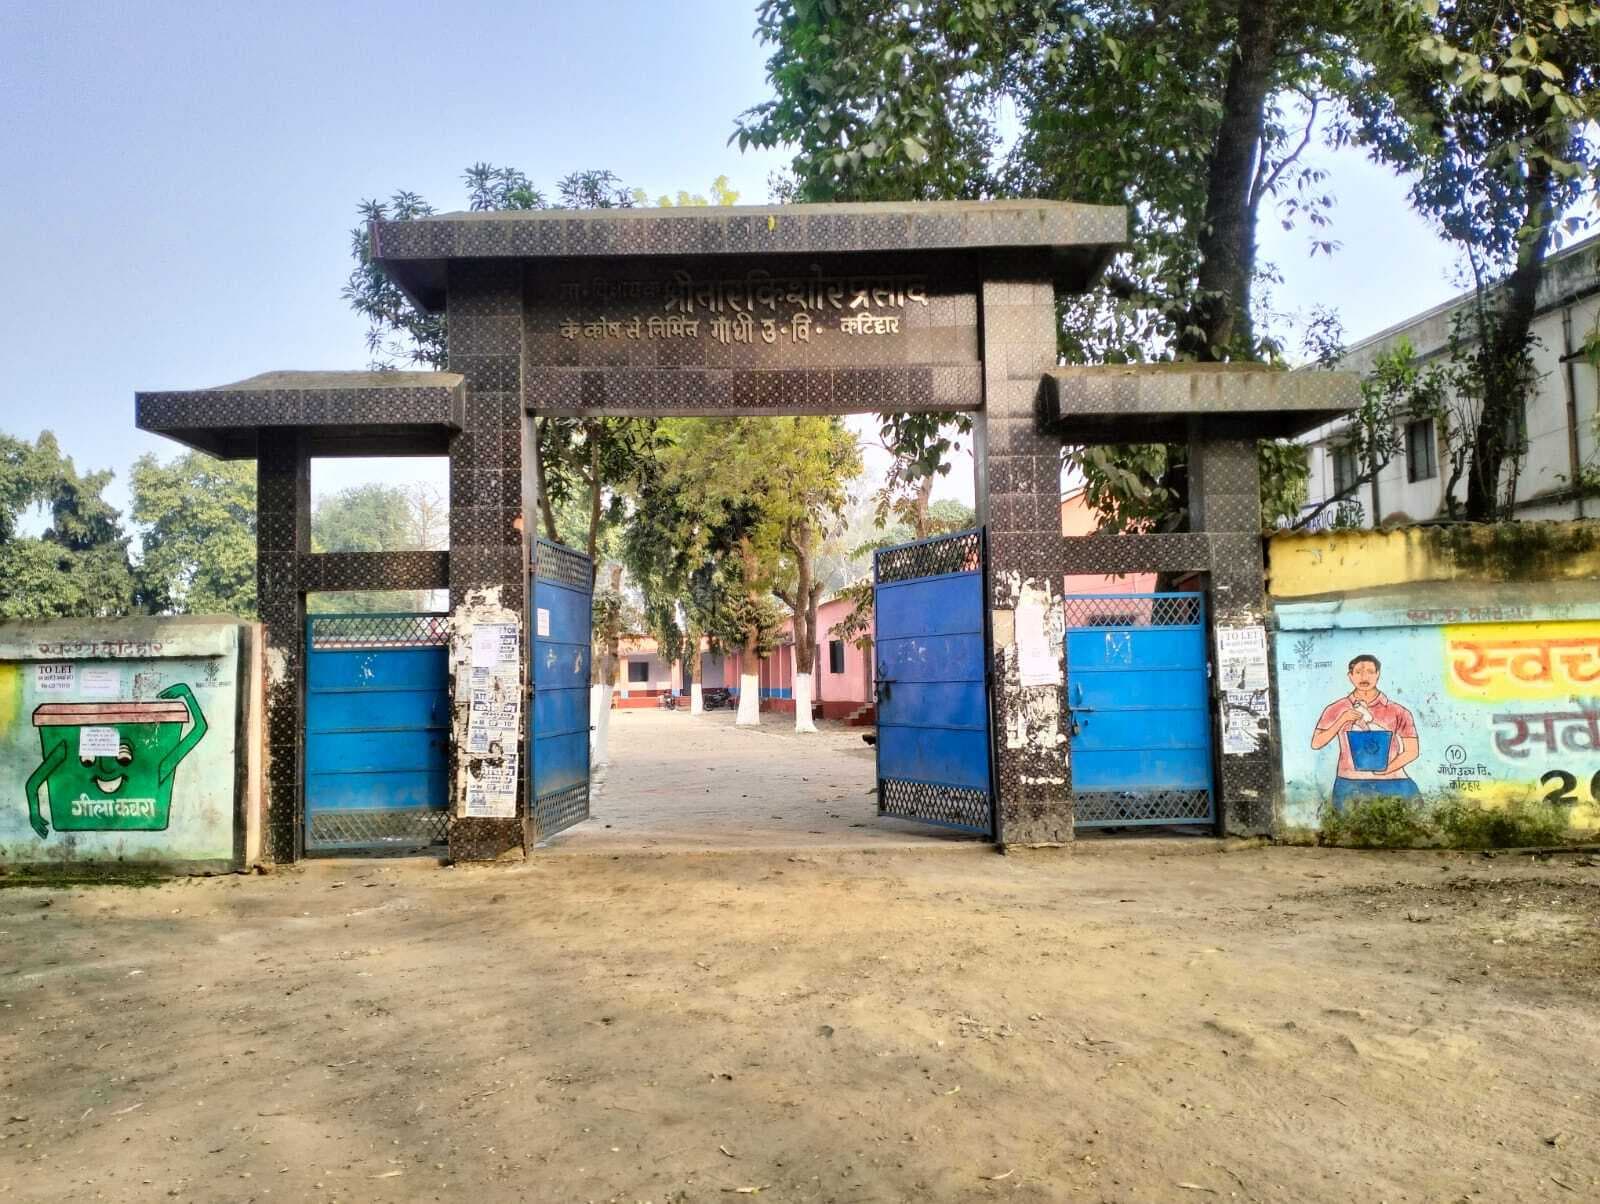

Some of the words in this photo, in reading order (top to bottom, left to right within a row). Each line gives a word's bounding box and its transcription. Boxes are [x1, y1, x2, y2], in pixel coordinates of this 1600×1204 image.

[624, 316, 641, 339] से
[840, 311, 899, 336] कटिहार
[38, 665, 53, 675] TO
[55, 665, 73, 675] LET
[1450, 749, 1462, 760] 10
[1540, 770, 1600, 806] 2
[71, 793, 115, 819] गीला
[115, 797, 156, 818] कचरा
